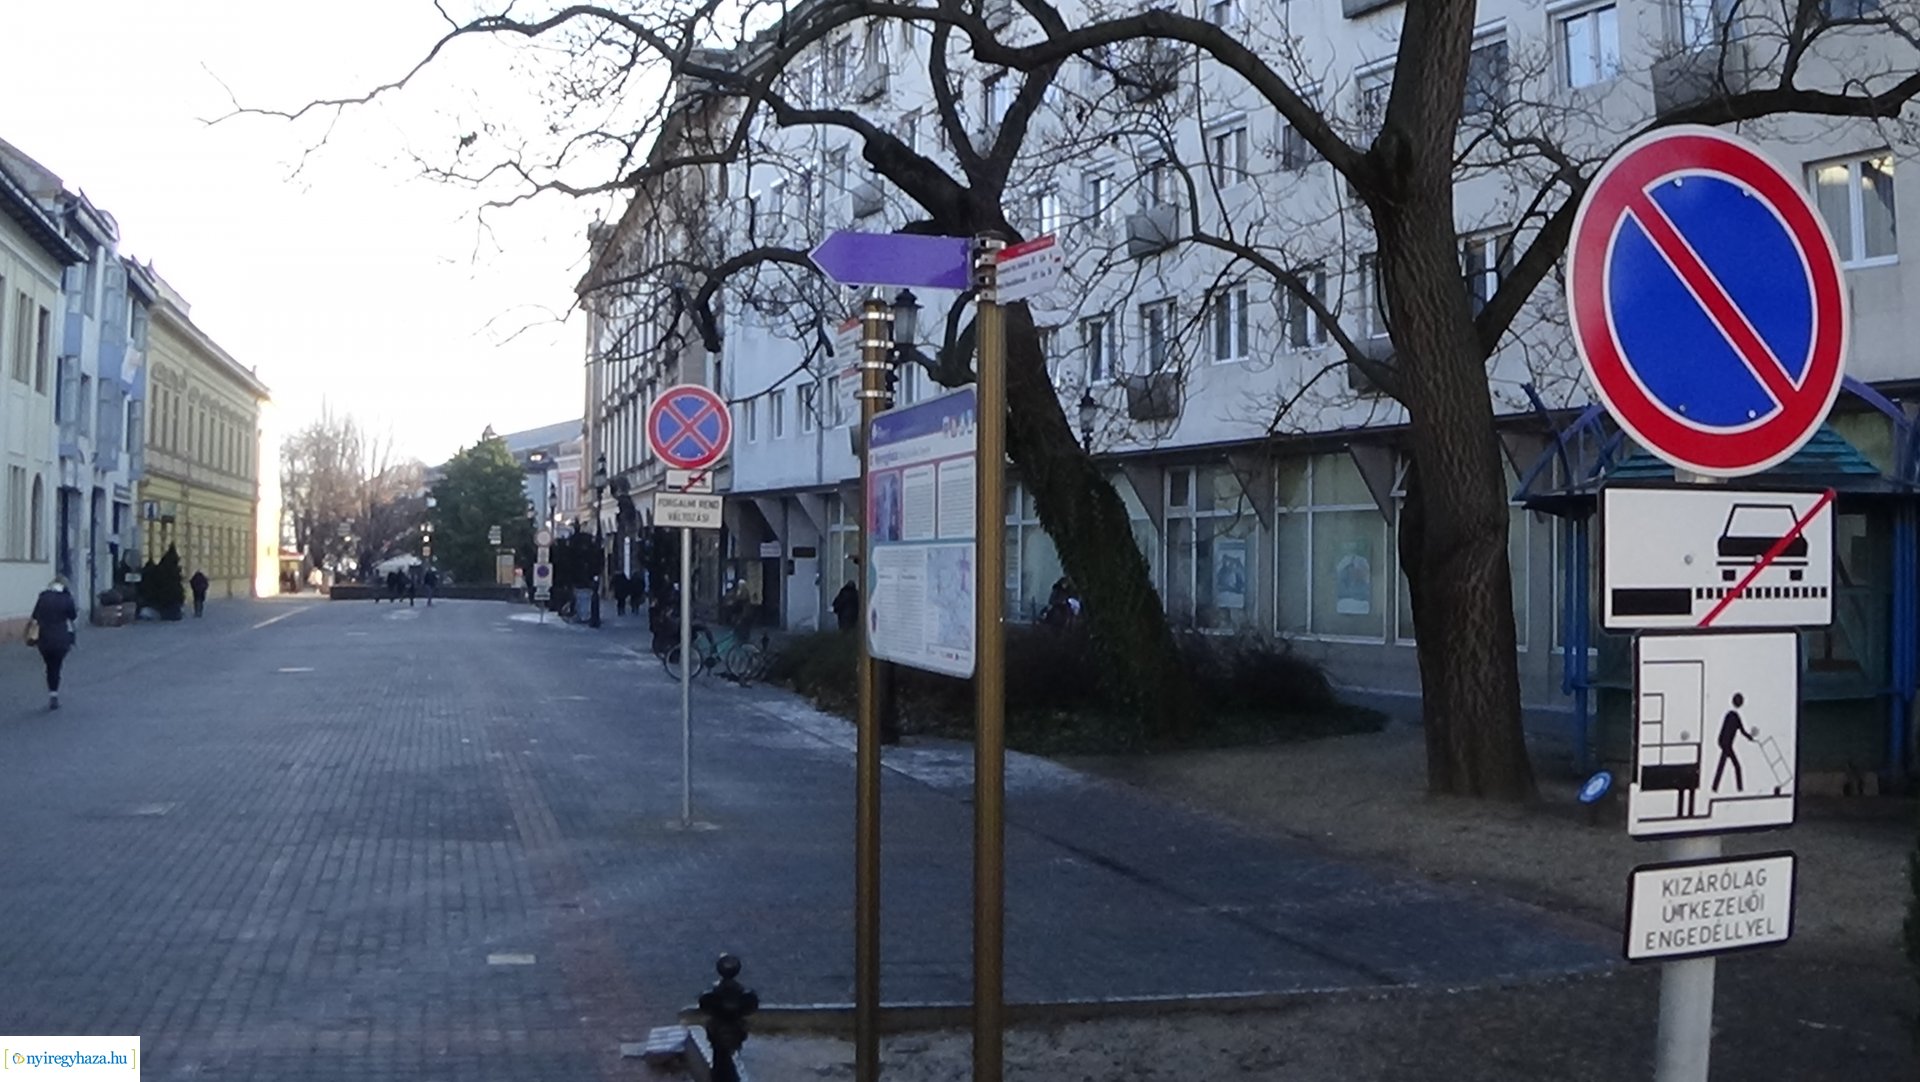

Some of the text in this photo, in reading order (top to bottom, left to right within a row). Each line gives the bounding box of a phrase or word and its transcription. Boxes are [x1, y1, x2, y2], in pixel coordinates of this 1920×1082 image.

[1662, 868, 1767, 897] KIZÁRÓLAG
[1662, 890, 1765, 923] ÚTKEZELŐI
[1646, 918, 1775, 950] ENGEDÉLLYEL
